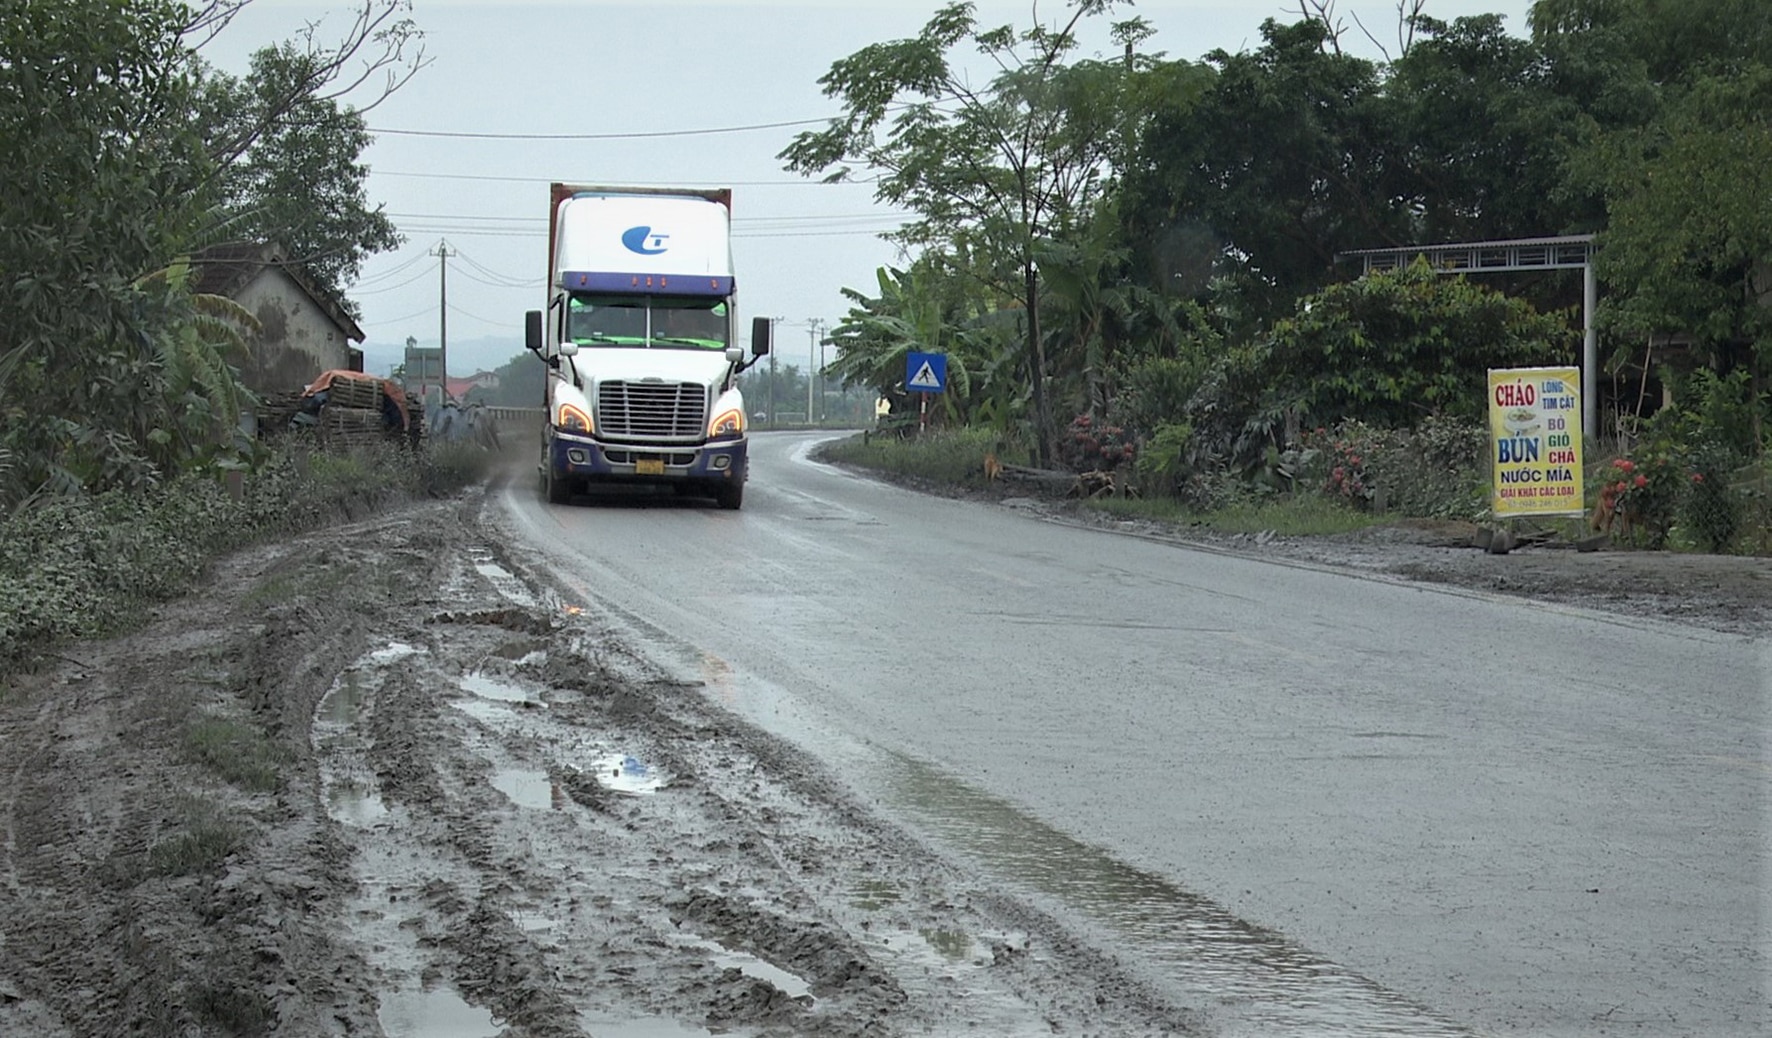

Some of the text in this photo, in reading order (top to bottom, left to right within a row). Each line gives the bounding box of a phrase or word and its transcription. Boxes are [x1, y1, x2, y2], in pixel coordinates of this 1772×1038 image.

[1495, 378, 1535, 407] CHÁO
[1542, 397, 1558, 410] TIM
[1498, 430, 1539, 463] BÚN
[1501, 466, 1573, 483] NƯỚC MÍA
